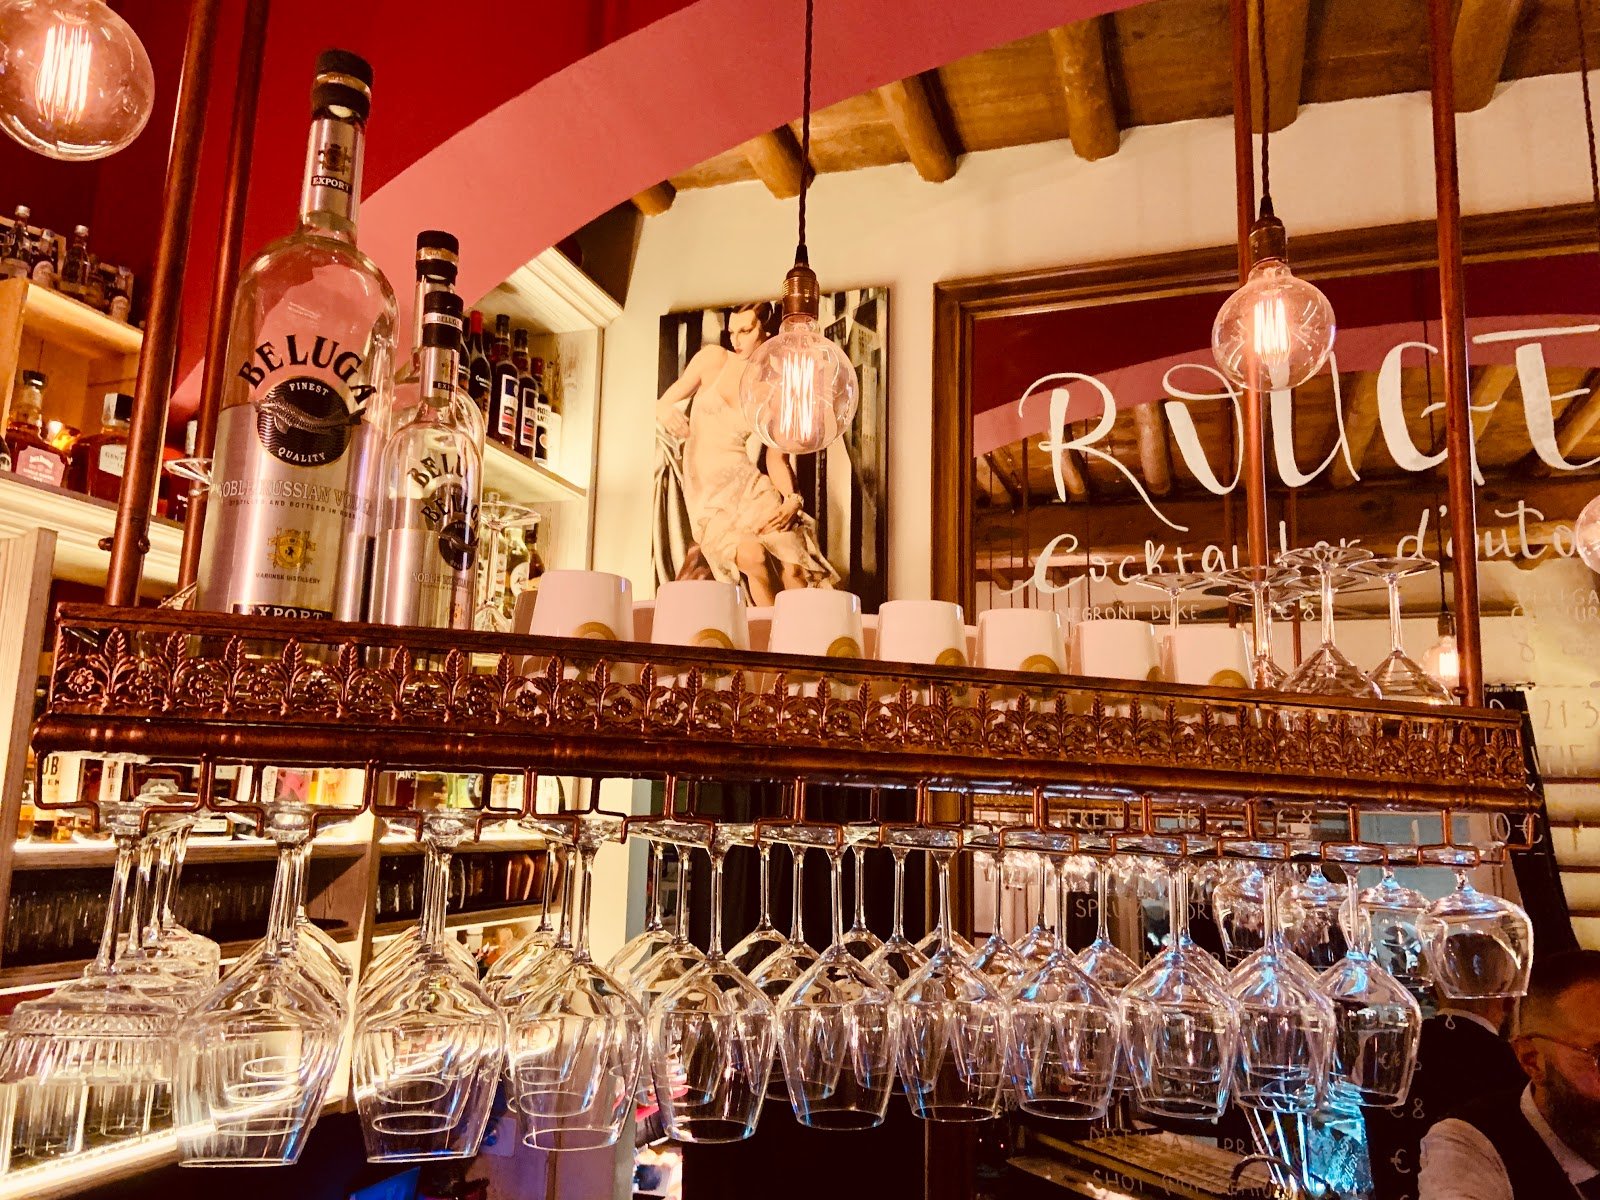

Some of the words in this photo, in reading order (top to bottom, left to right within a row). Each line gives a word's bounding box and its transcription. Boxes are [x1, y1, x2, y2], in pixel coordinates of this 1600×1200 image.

[312, 176, 350, 192] EXPORT
[237, 334, 377, 405] BELUGA
[288, 382, 329, 396] FINEST
[278, 446, 326, 463] QUALITY
[998, 533, 1242, 597] Cocktai
[1151, 604, 1200, 621] DUKE
[1412, 1097, 1425, 1119] 8
